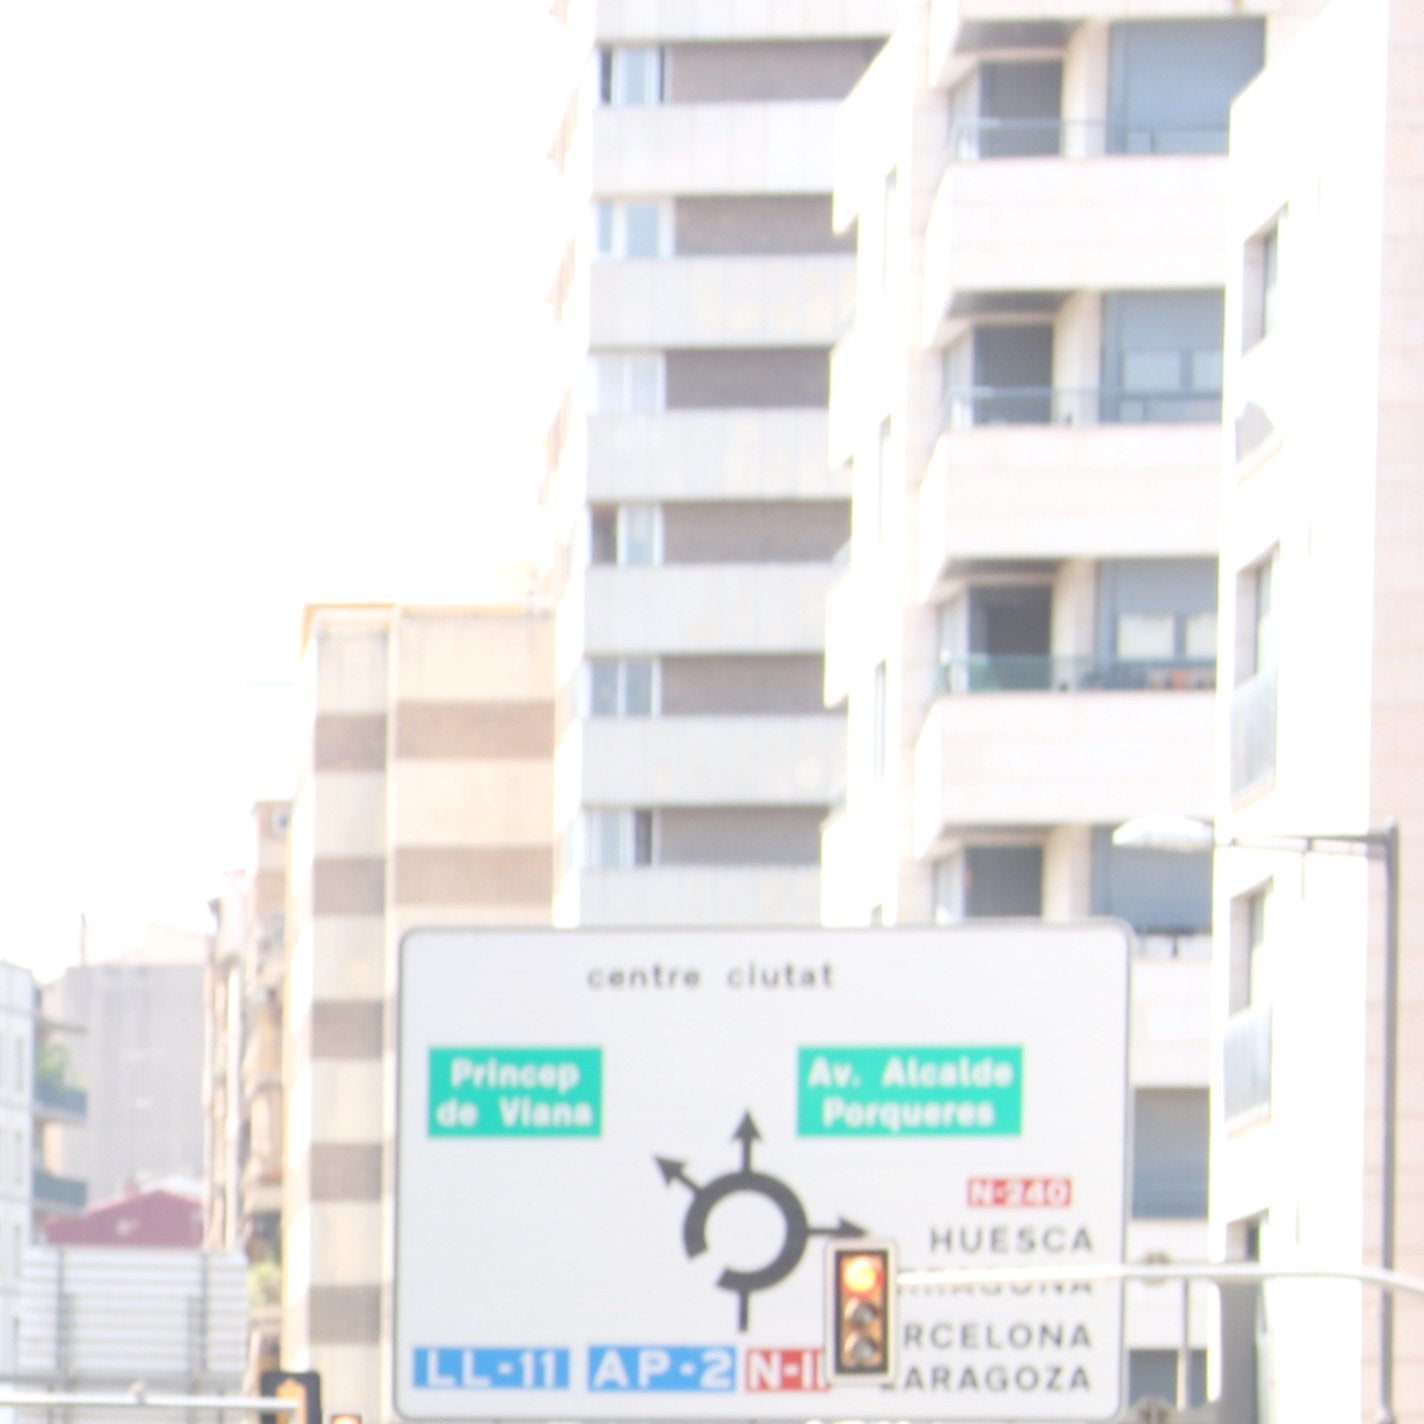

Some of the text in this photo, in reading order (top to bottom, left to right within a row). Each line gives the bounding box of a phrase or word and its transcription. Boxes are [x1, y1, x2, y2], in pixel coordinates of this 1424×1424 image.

[588, 962, 834, 989] centre ciutat
[451, 1058, 580, 1094] Princep
[808, 1058, 1013, 1088] Av. Alcalde
[436, 1098, 593, 1128] de Viana
[823, 1098, 995, 1133] Porqueres
[968, 1179, 1070, 1206] N-240
[930, 1226, 1095, 1253] HUESCA
[903, 1323, 1092, 1349] RCELONA
[426, 1352, 555, 1389] LL-11
[592, 1350, 732, 1388] AP-2
[883, 1365, 1090, 1391] ARAGOZA
